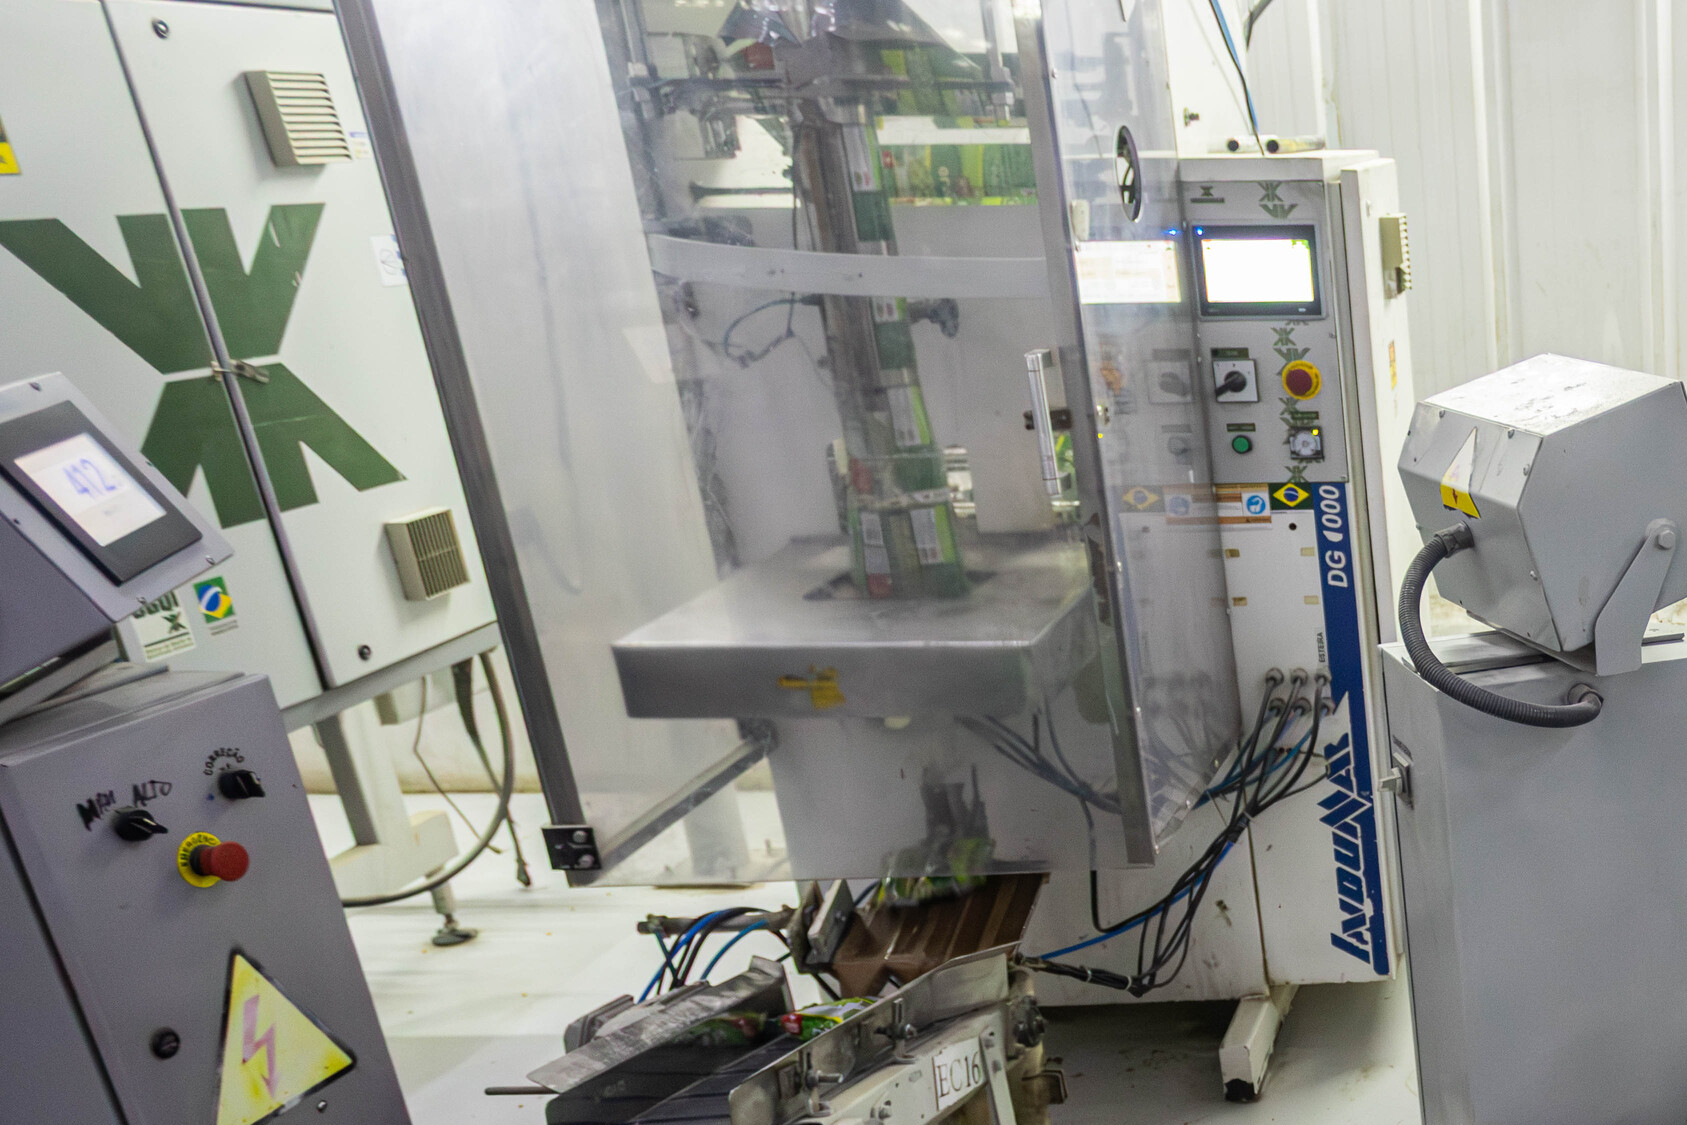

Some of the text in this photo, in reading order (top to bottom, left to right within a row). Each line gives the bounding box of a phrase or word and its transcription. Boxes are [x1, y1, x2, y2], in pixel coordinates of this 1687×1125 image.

[1318, 485, 1349, 589] DG 1000
[936, 1051, 981, 1098] EC16
